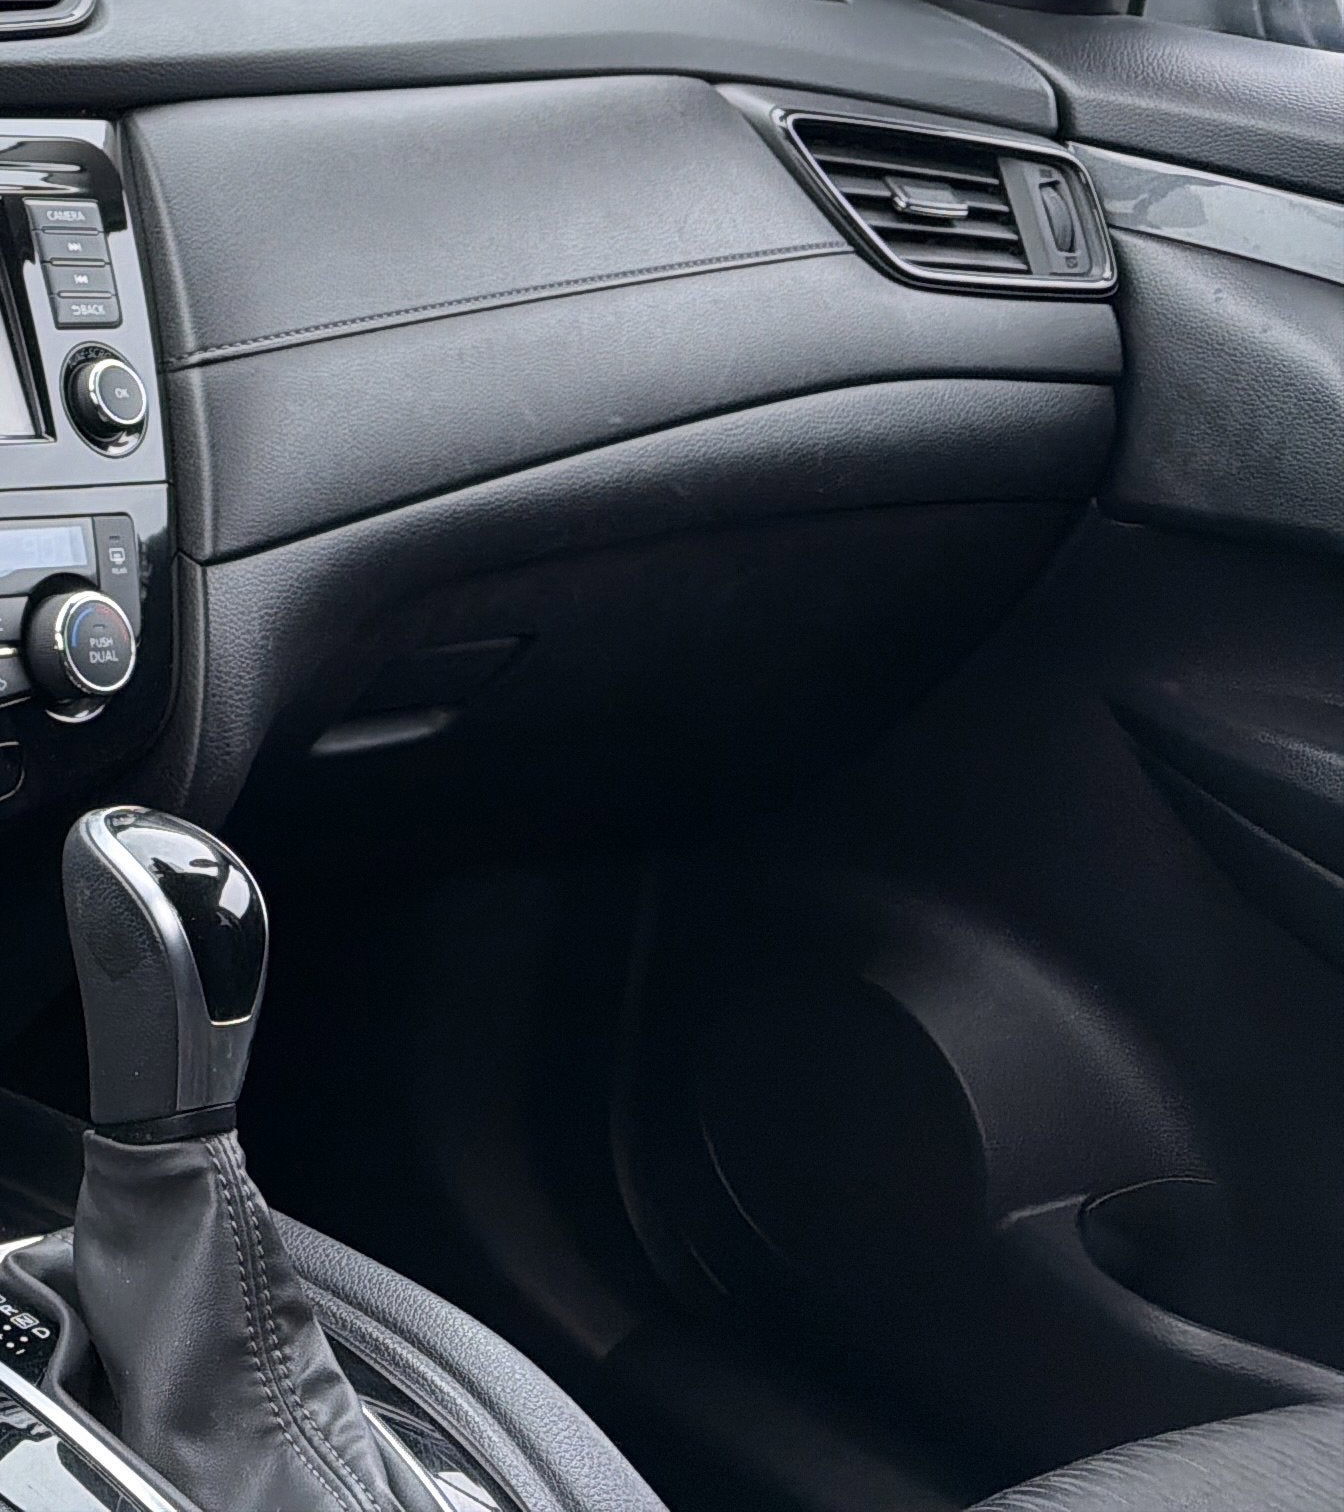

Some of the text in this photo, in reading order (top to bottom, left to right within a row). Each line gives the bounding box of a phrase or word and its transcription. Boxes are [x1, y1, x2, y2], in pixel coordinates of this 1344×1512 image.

[46, 210, 86, 221] CAMERA
[80, 304, 106, 316] BACK
[114, 387, 130, 399] OK
[89, 636, 113, 648] PUSH
[89, 650, 119, 664] DUAL
